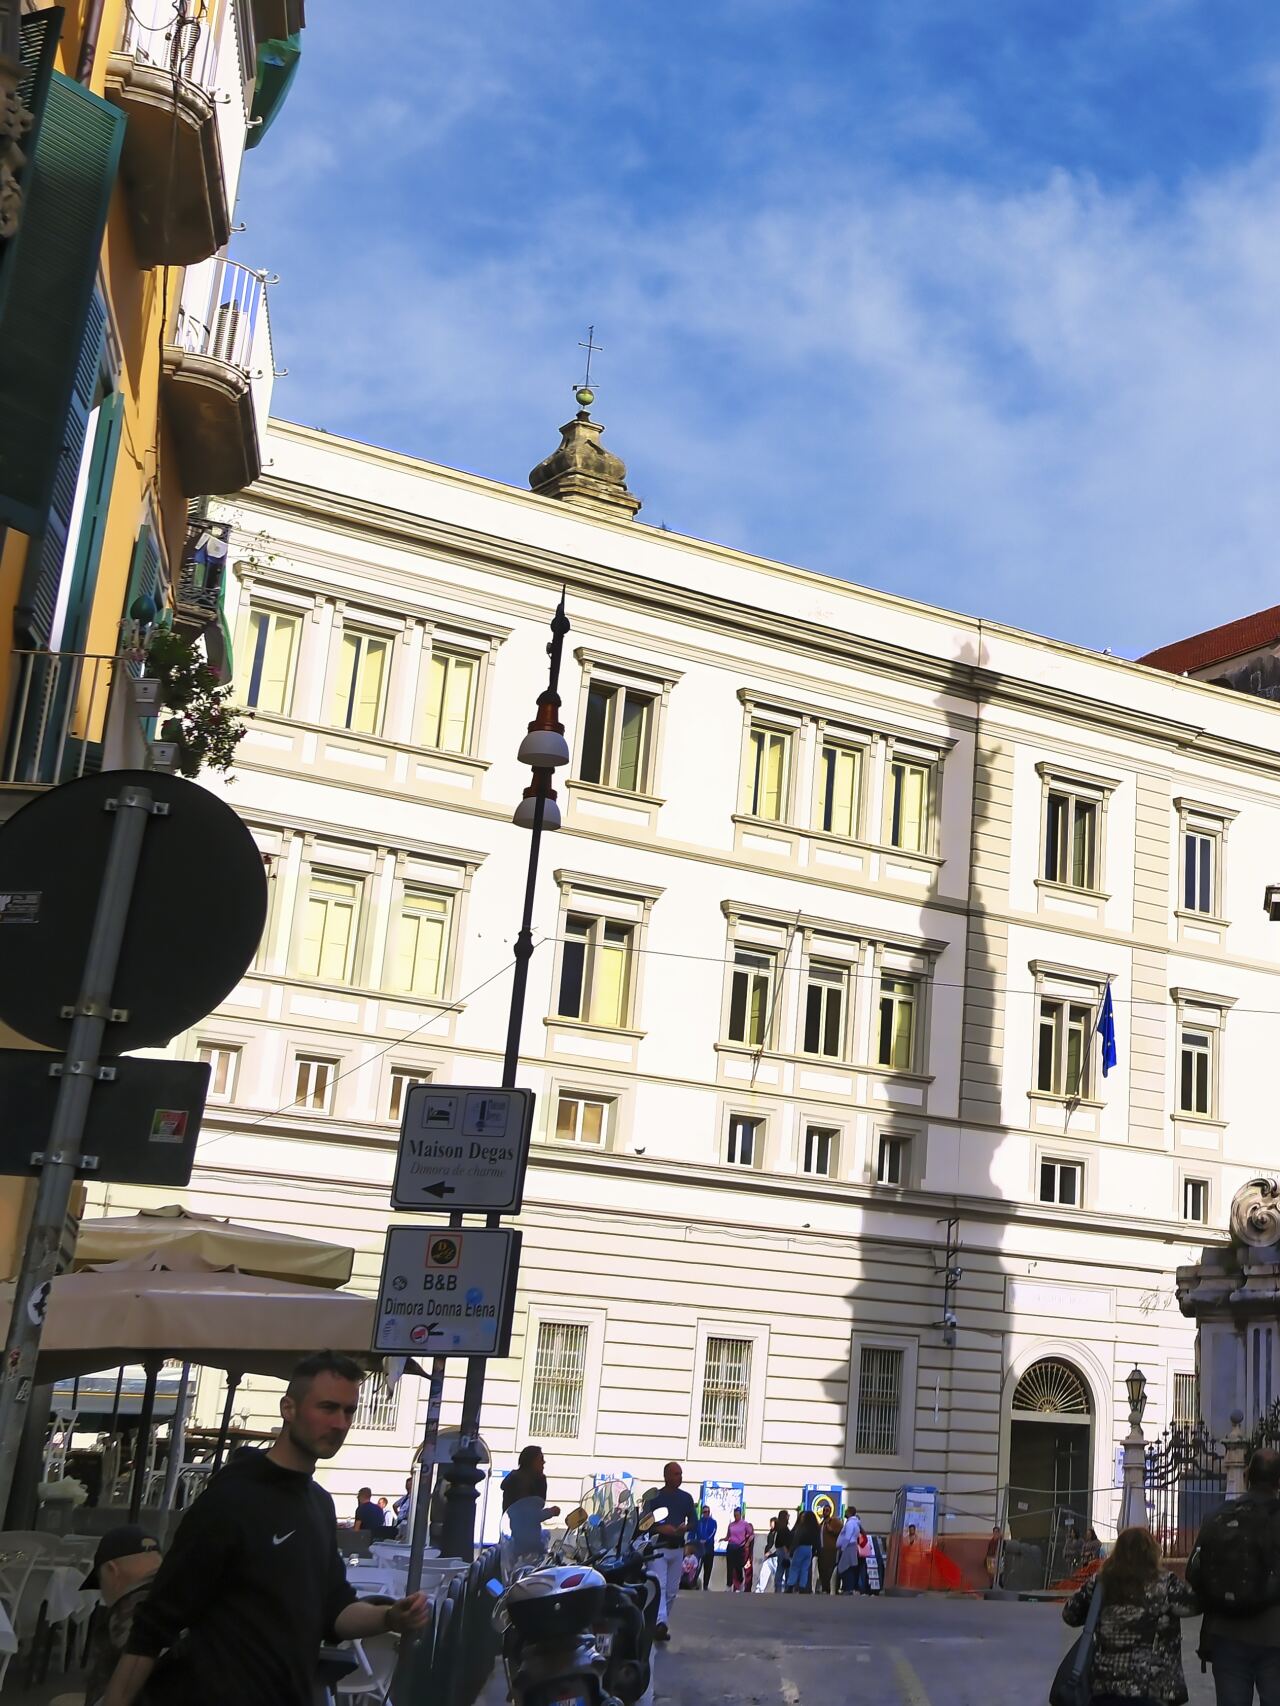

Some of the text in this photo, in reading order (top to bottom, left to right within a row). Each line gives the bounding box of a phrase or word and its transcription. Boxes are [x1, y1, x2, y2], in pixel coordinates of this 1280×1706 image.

[409, 1139, 514, 1164] Maison Degas
[409, 1162, 450, 1177] Dimora
[452, 1164, 466, 1176] de
[423, 1274, 458, 1292] B&B
[384, 1298, 496, 1319] Dimora Donna Elena
